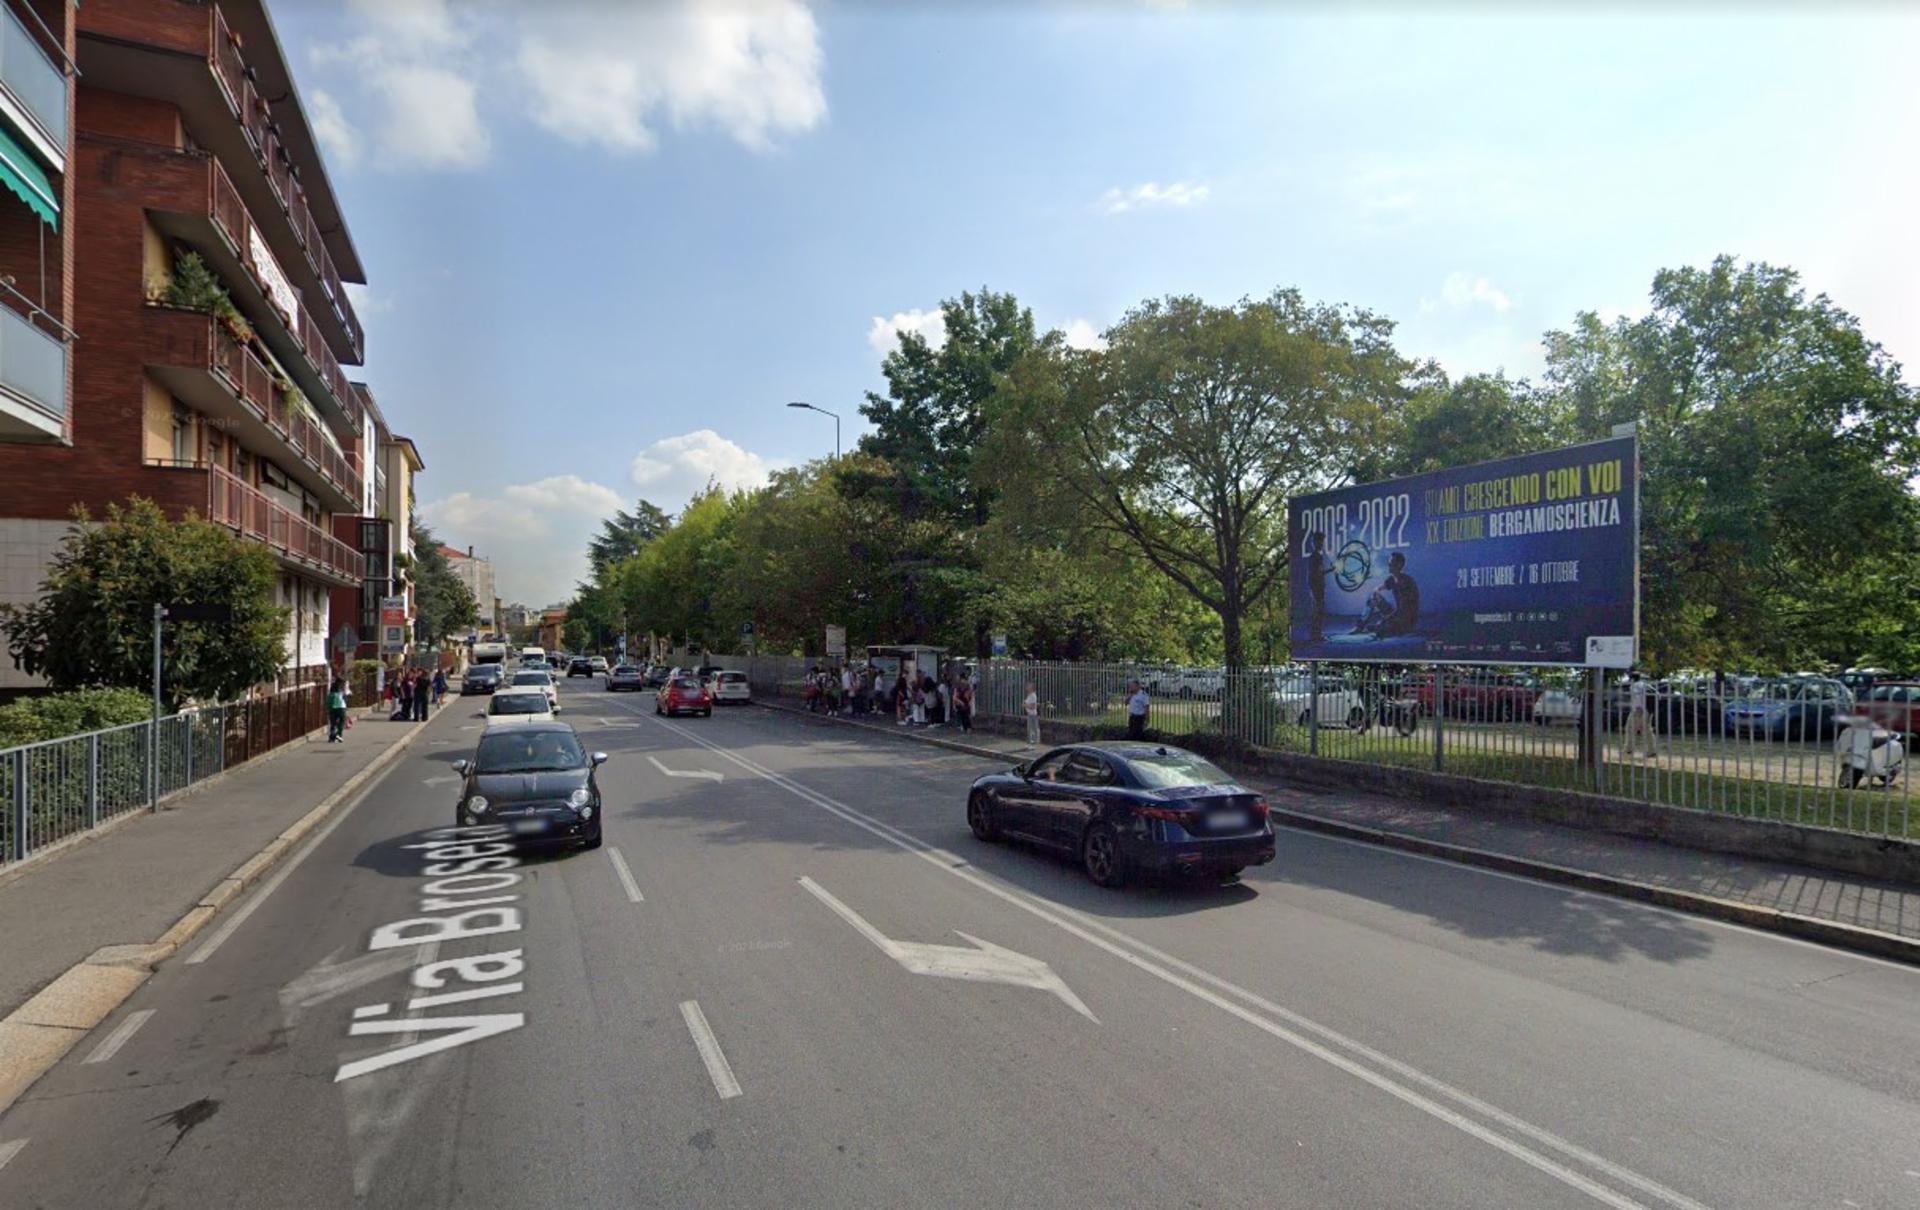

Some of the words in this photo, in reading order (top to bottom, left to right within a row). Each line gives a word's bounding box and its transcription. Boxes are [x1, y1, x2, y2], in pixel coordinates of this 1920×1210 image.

[1464, 472, 1540, 512] CRESCENDO
[1546, 466, 1582, 501] CON
[1588, 459, 1622, 495] VOI
[1358, 493, 1411, 551] 2022
[1426, 520, 1440, 545] XX
[1443, 514, 1485, 543] EDIZIONE
[1489, 497, 1621, 538] BERGAMOSCIENZA
[1470, 564, 1517, 588] SETTEMBRE
[1541, 559, 1581, 584] OTTOBRE
